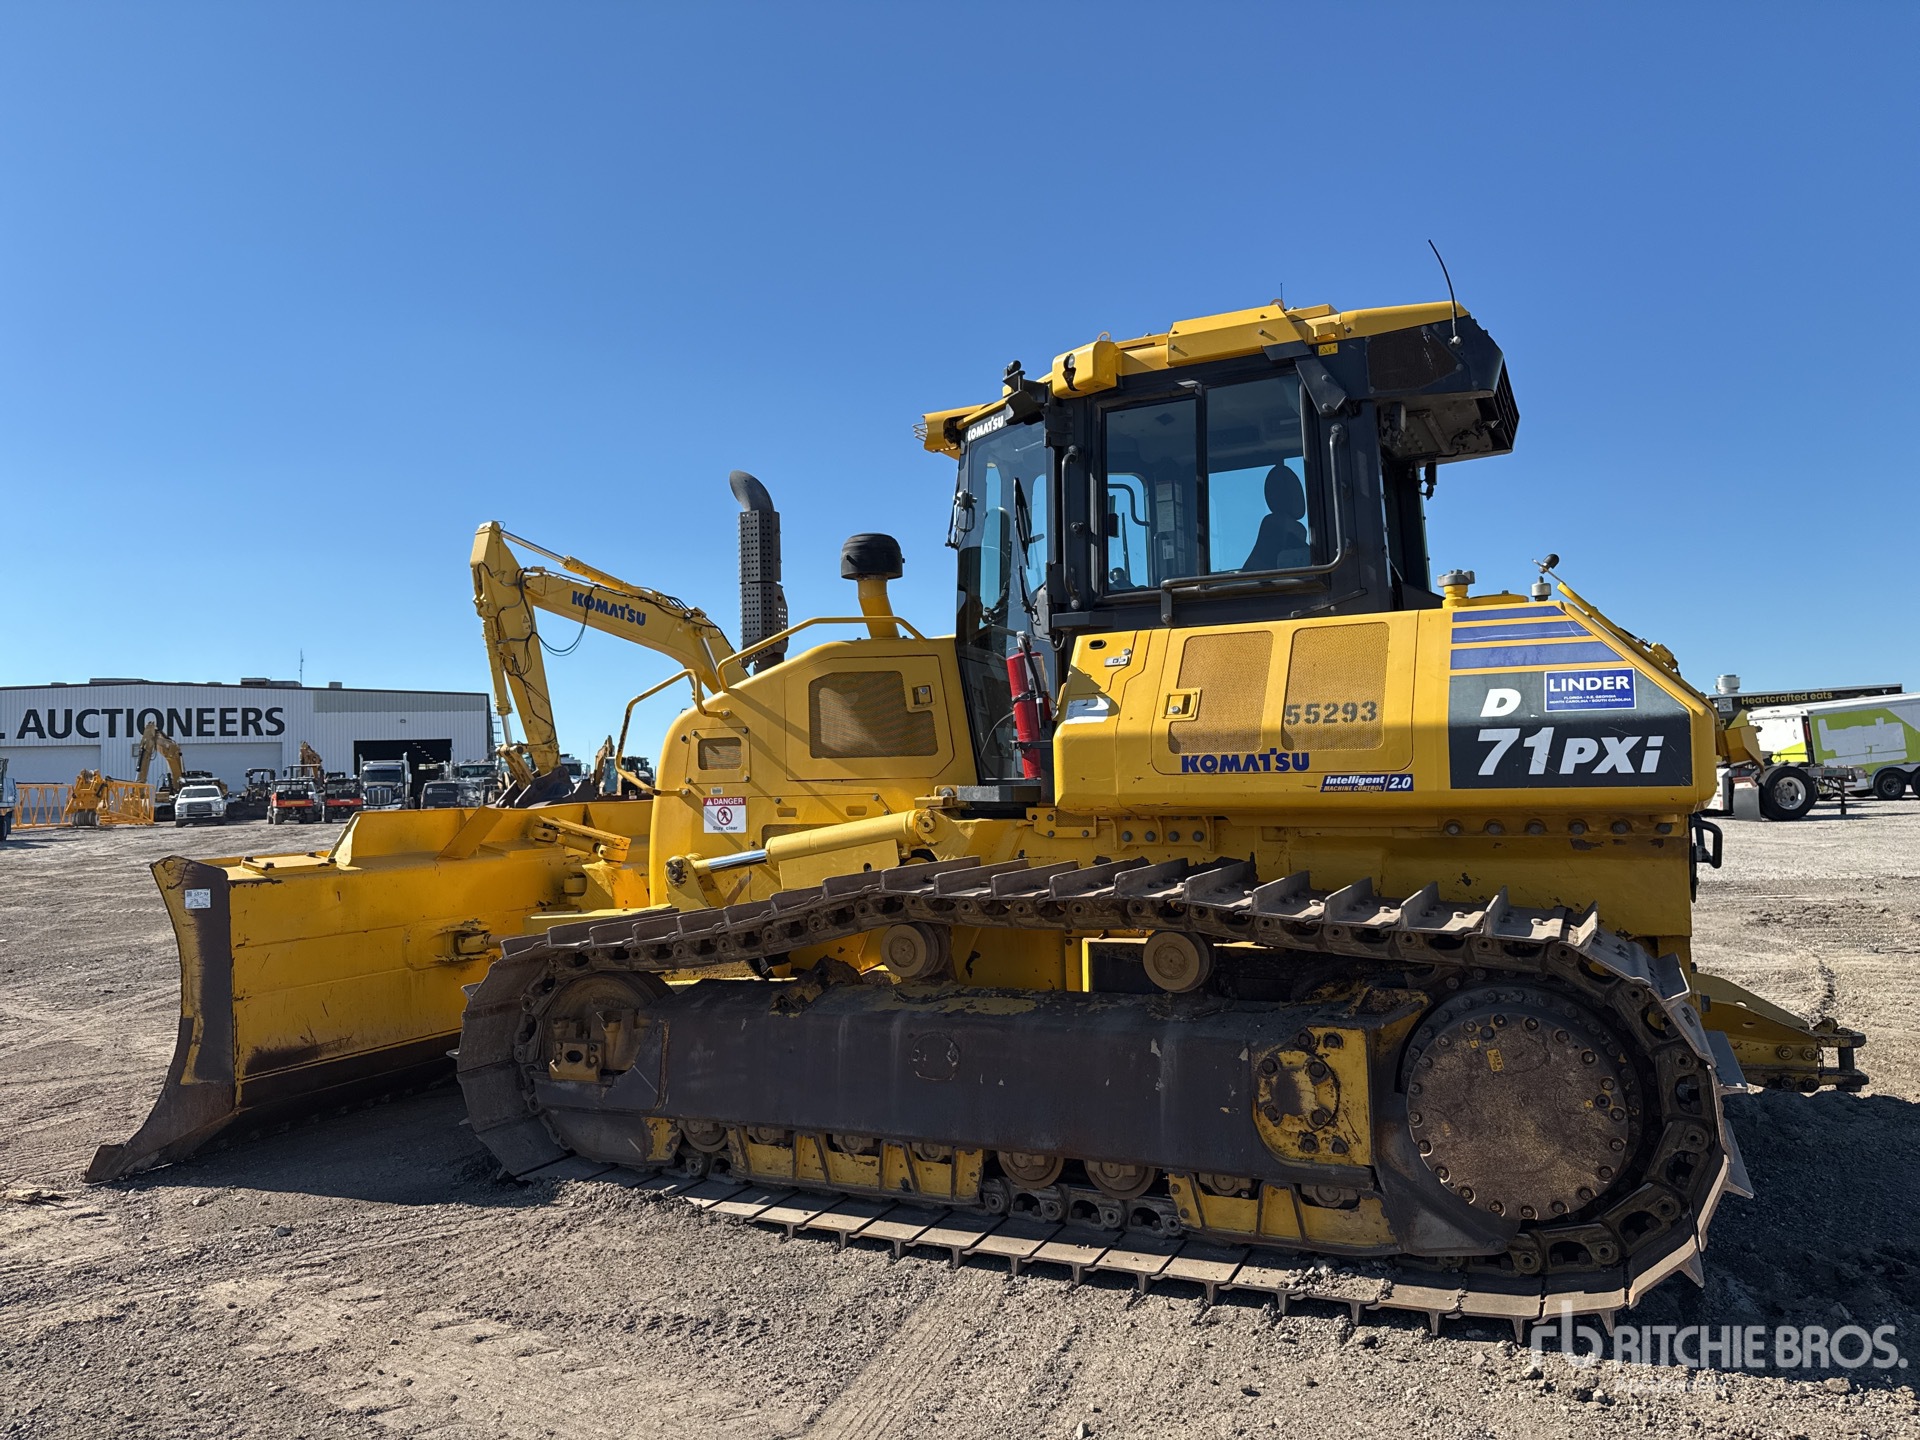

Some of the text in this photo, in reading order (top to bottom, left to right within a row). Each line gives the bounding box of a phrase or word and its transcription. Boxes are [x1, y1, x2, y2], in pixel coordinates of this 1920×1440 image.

[571, 590, 647, 627] KOMATSU
[1549, 675, 1631, 692] LINDER
[1480, 688, 1522, 717] D
[1741, 691, 1833, 705] Heartcrafted eats
[16, 707, 286, 740] AUCTIONEERS
[1284, 700, 1378, 726] 55293
[1181, 747, 1310, 774] KOMATSU
[1325, 775, 1412, 789] intelligent 2.0
[713, 797, 744, 805] DANGER
